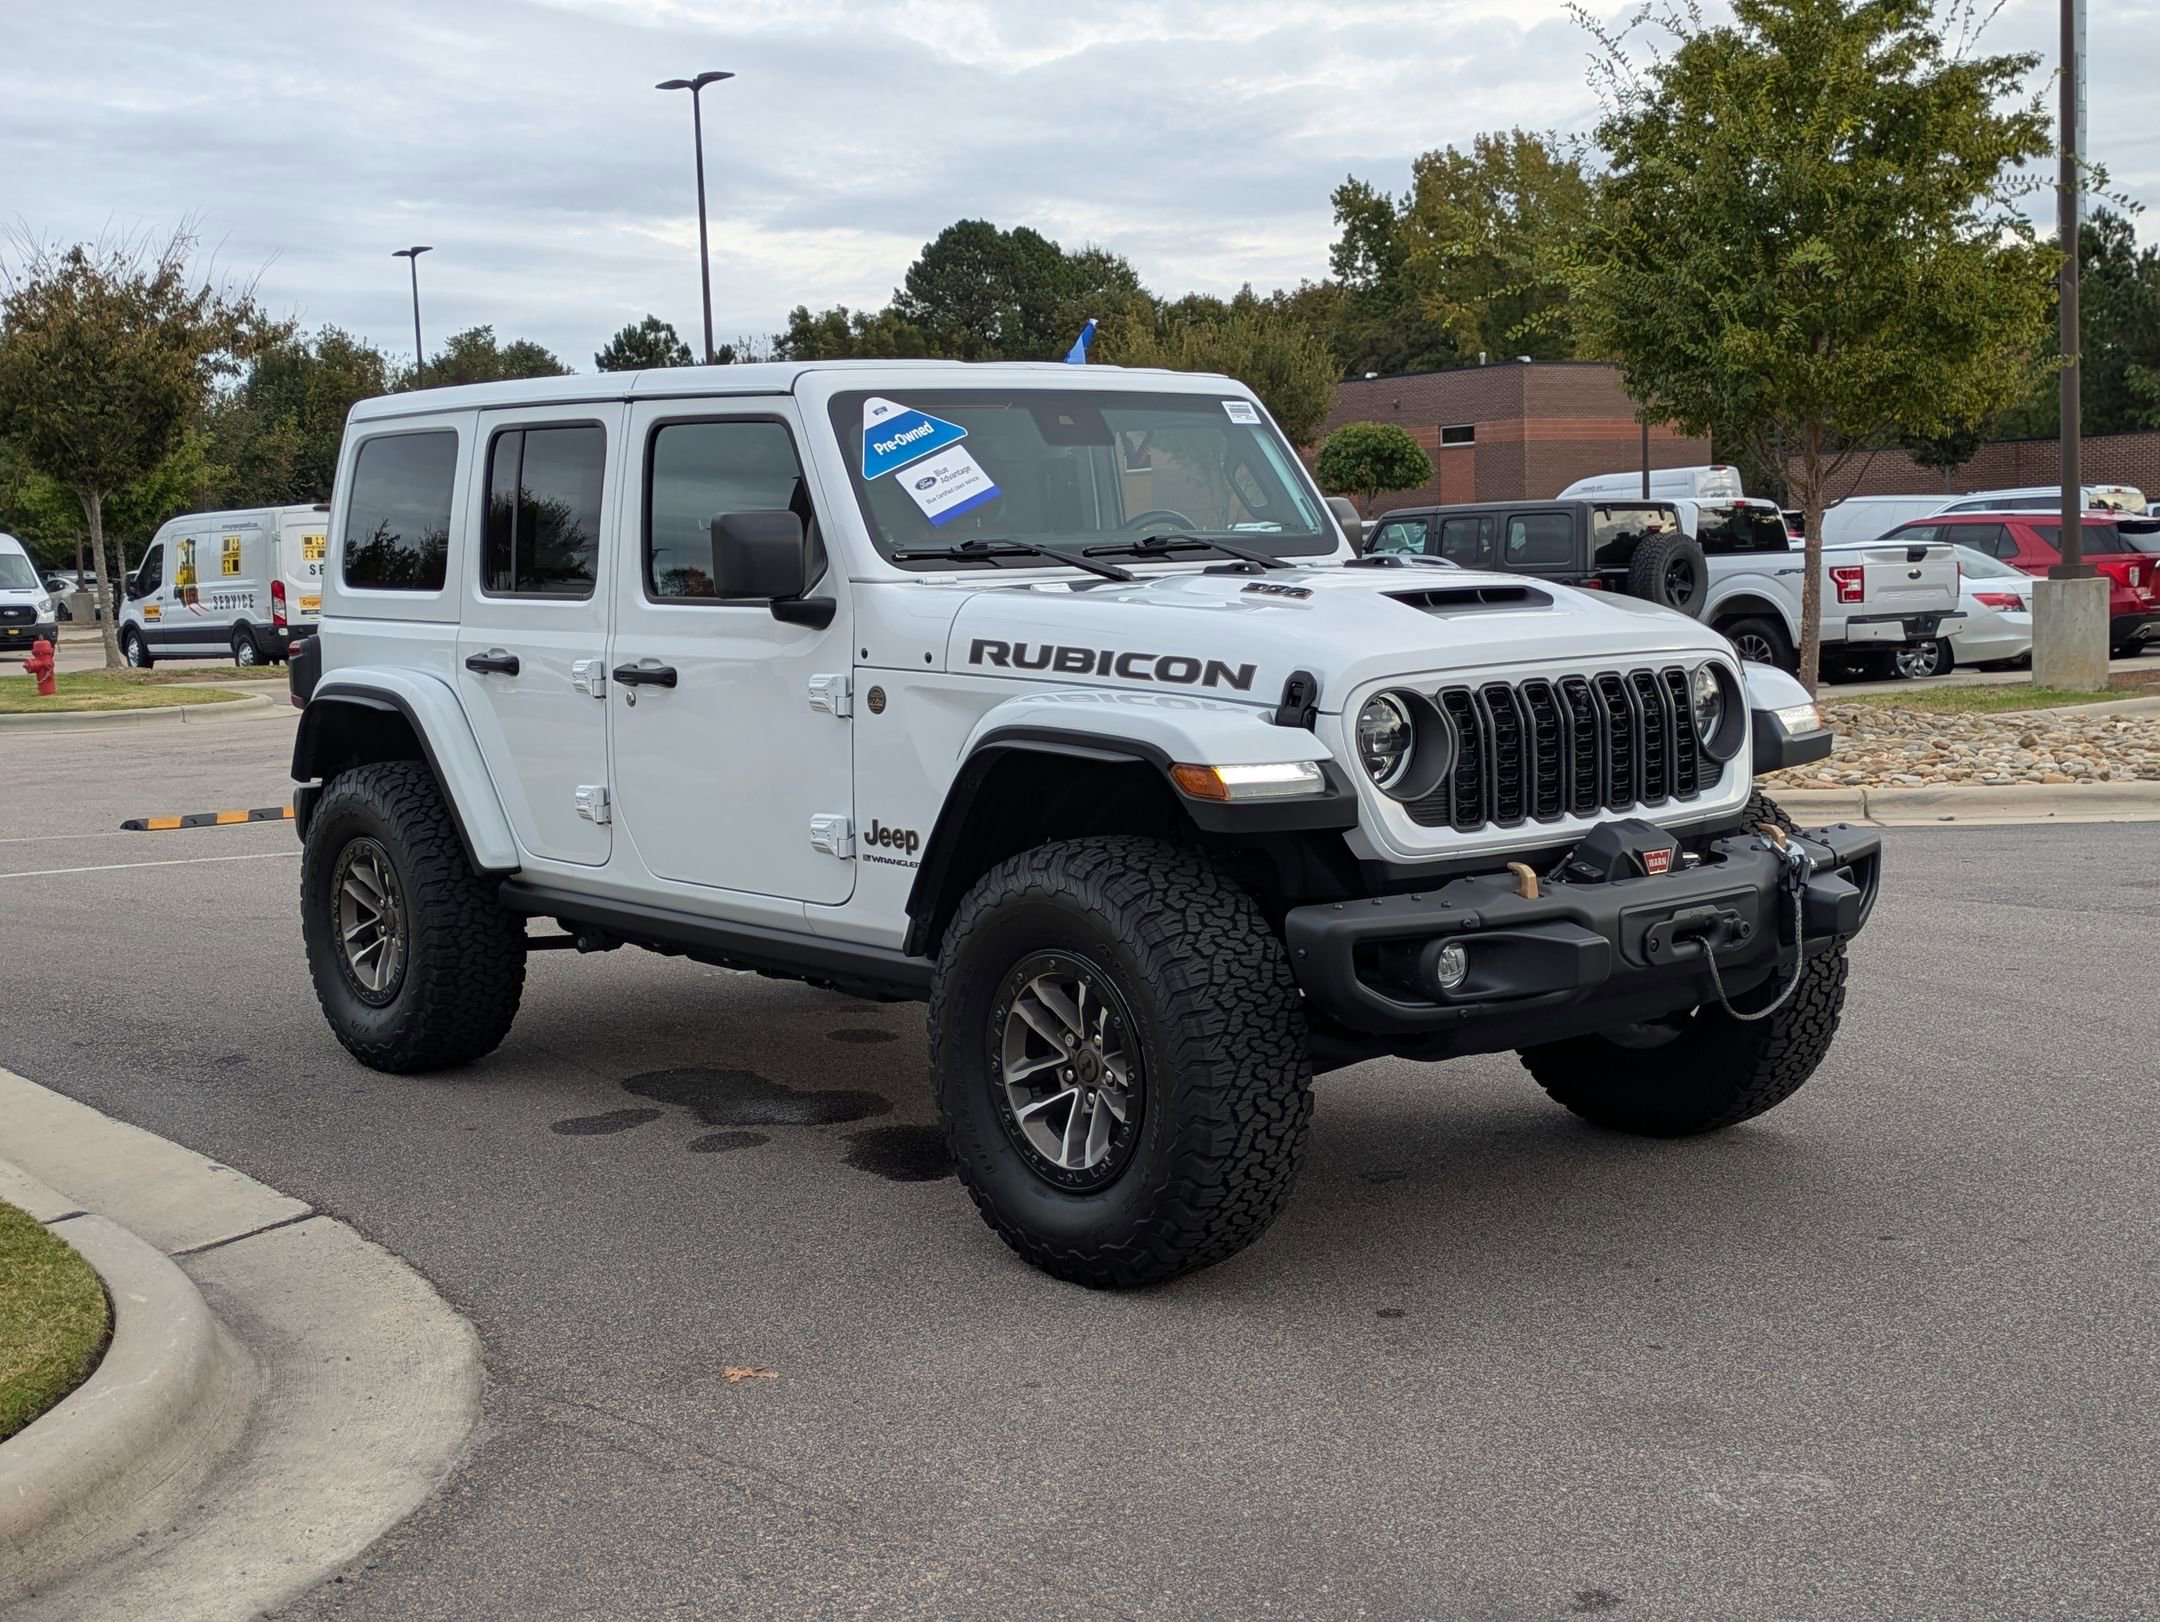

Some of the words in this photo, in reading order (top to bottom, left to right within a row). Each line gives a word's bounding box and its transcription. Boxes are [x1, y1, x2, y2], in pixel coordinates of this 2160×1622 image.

[873, 421, 935, 456] Pre-Owned
[933, 466, 949, 477] Blue
[940, 465, 972, 484] Advantage
[213, 594, 254, 610] SERVICE
[968, 638, 1258, 691] RUBICON
[864, 819, 920, 856] Jeep
[1648, 856, 1667, 867] WARN
